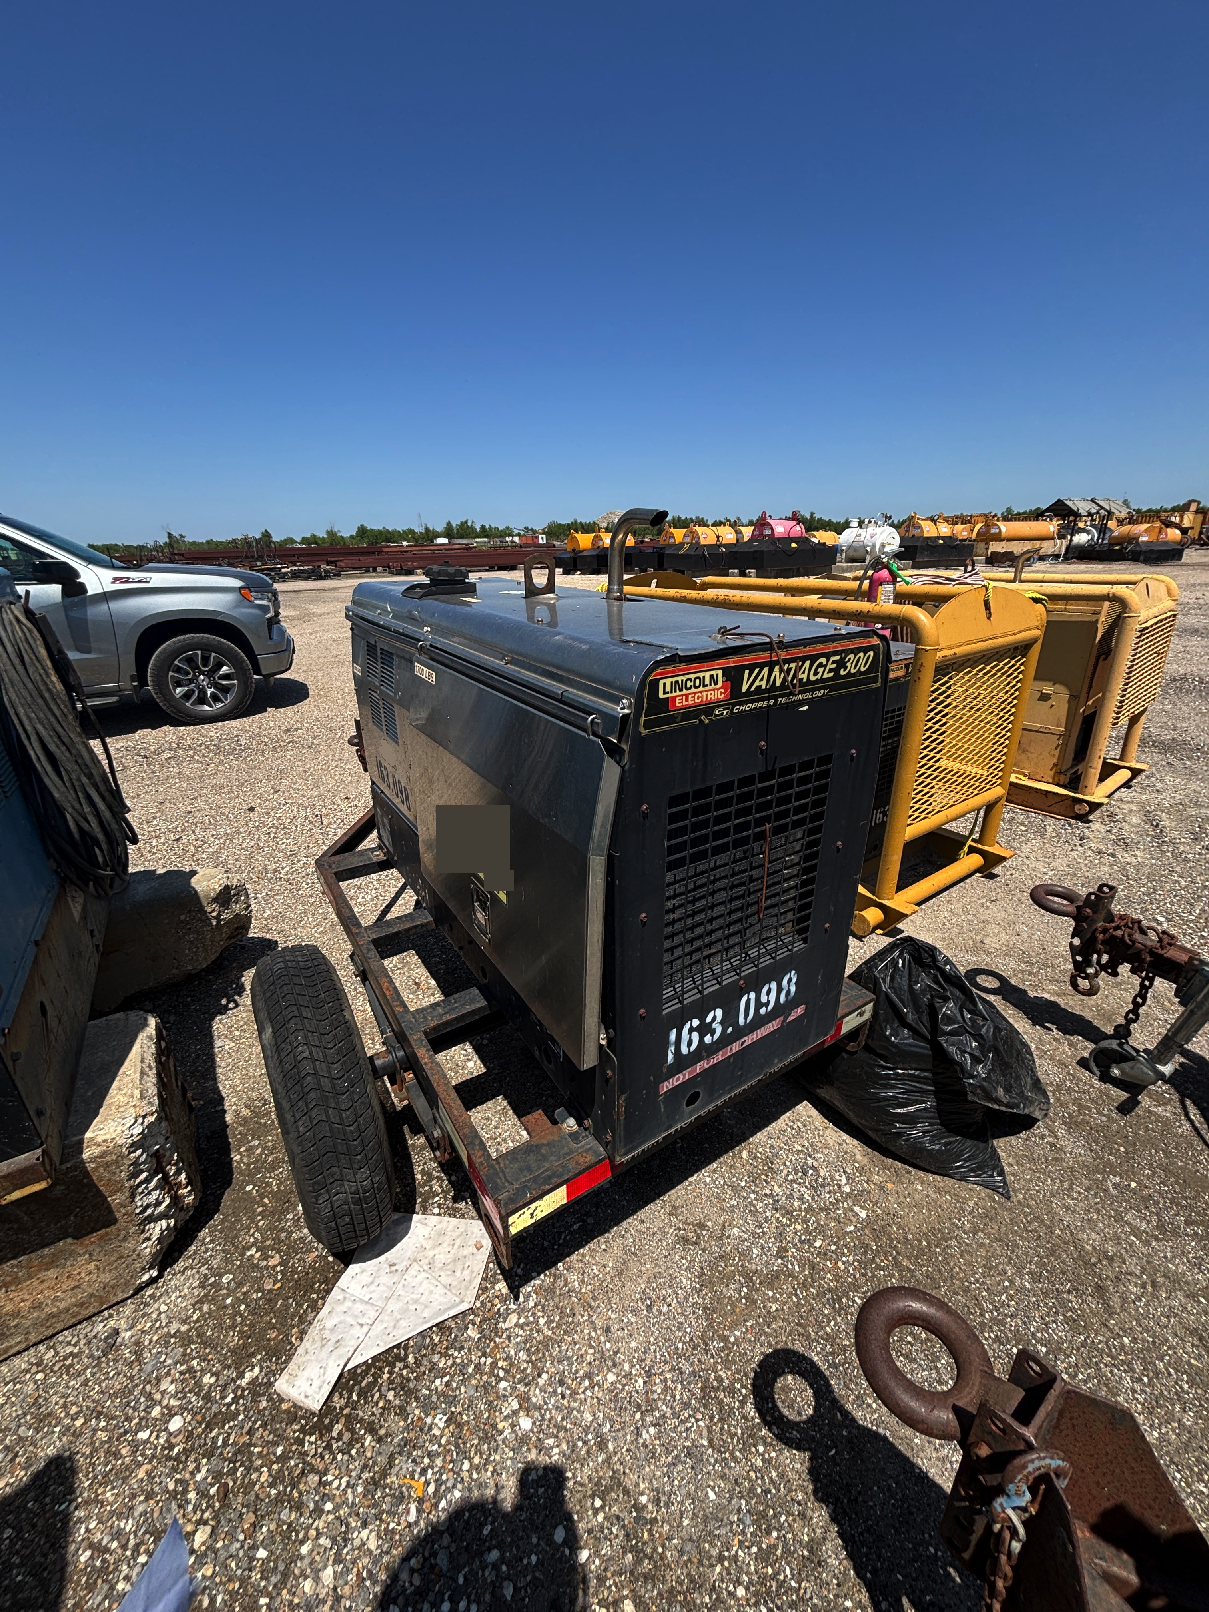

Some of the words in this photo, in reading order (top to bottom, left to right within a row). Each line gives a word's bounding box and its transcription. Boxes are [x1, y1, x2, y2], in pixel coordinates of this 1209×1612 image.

[741, 655, 841, 692] VANTAGE
[840, 651, 874, 676] 300
[662, 673, 719, 695] LINCOLN
[675, 689, 725, 707] ELECTRIC
[733, 699, 775, 713] CHOPPER
[777, 689, 830, 704] TECHNOLOGY
[667, 970, 798, 1065] 163.098
[663, 1068, 692, 1092] NOT
